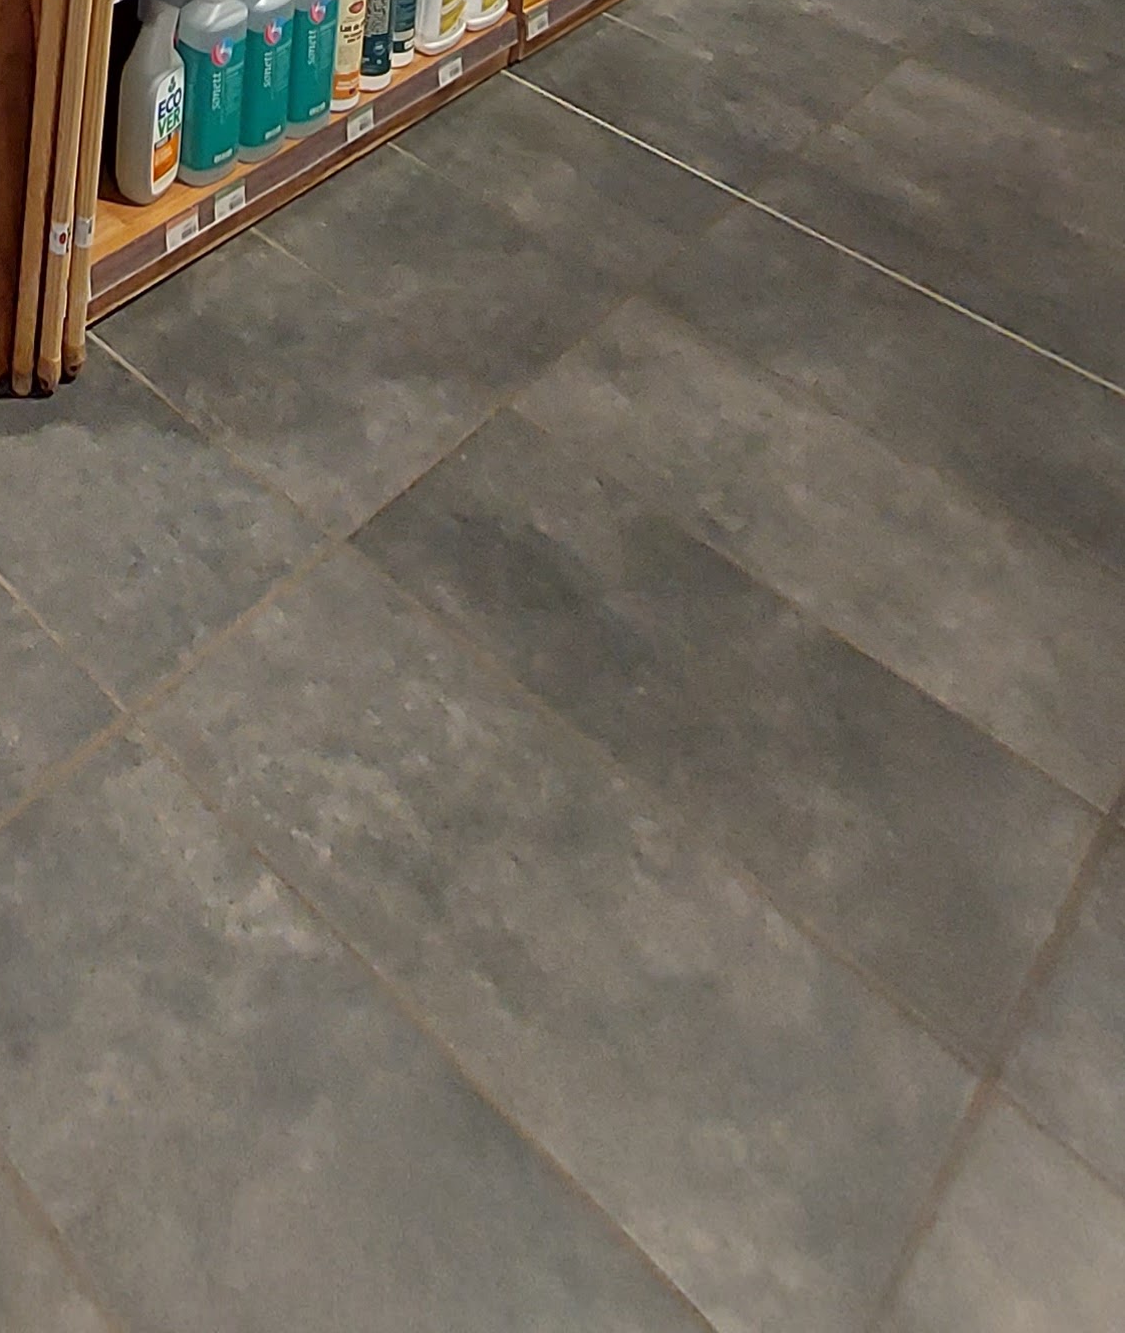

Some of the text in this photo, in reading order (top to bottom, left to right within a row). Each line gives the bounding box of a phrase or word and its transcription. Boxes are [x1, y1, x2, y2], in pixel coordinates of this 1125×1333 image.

[308, 30, 317, 65] sonett
[263, 52, 273, 88] sonett
[158, 88, 182, 119] ECO
[212, 72, 221, 110] sonett
[158, 110, 180, 137] VER
